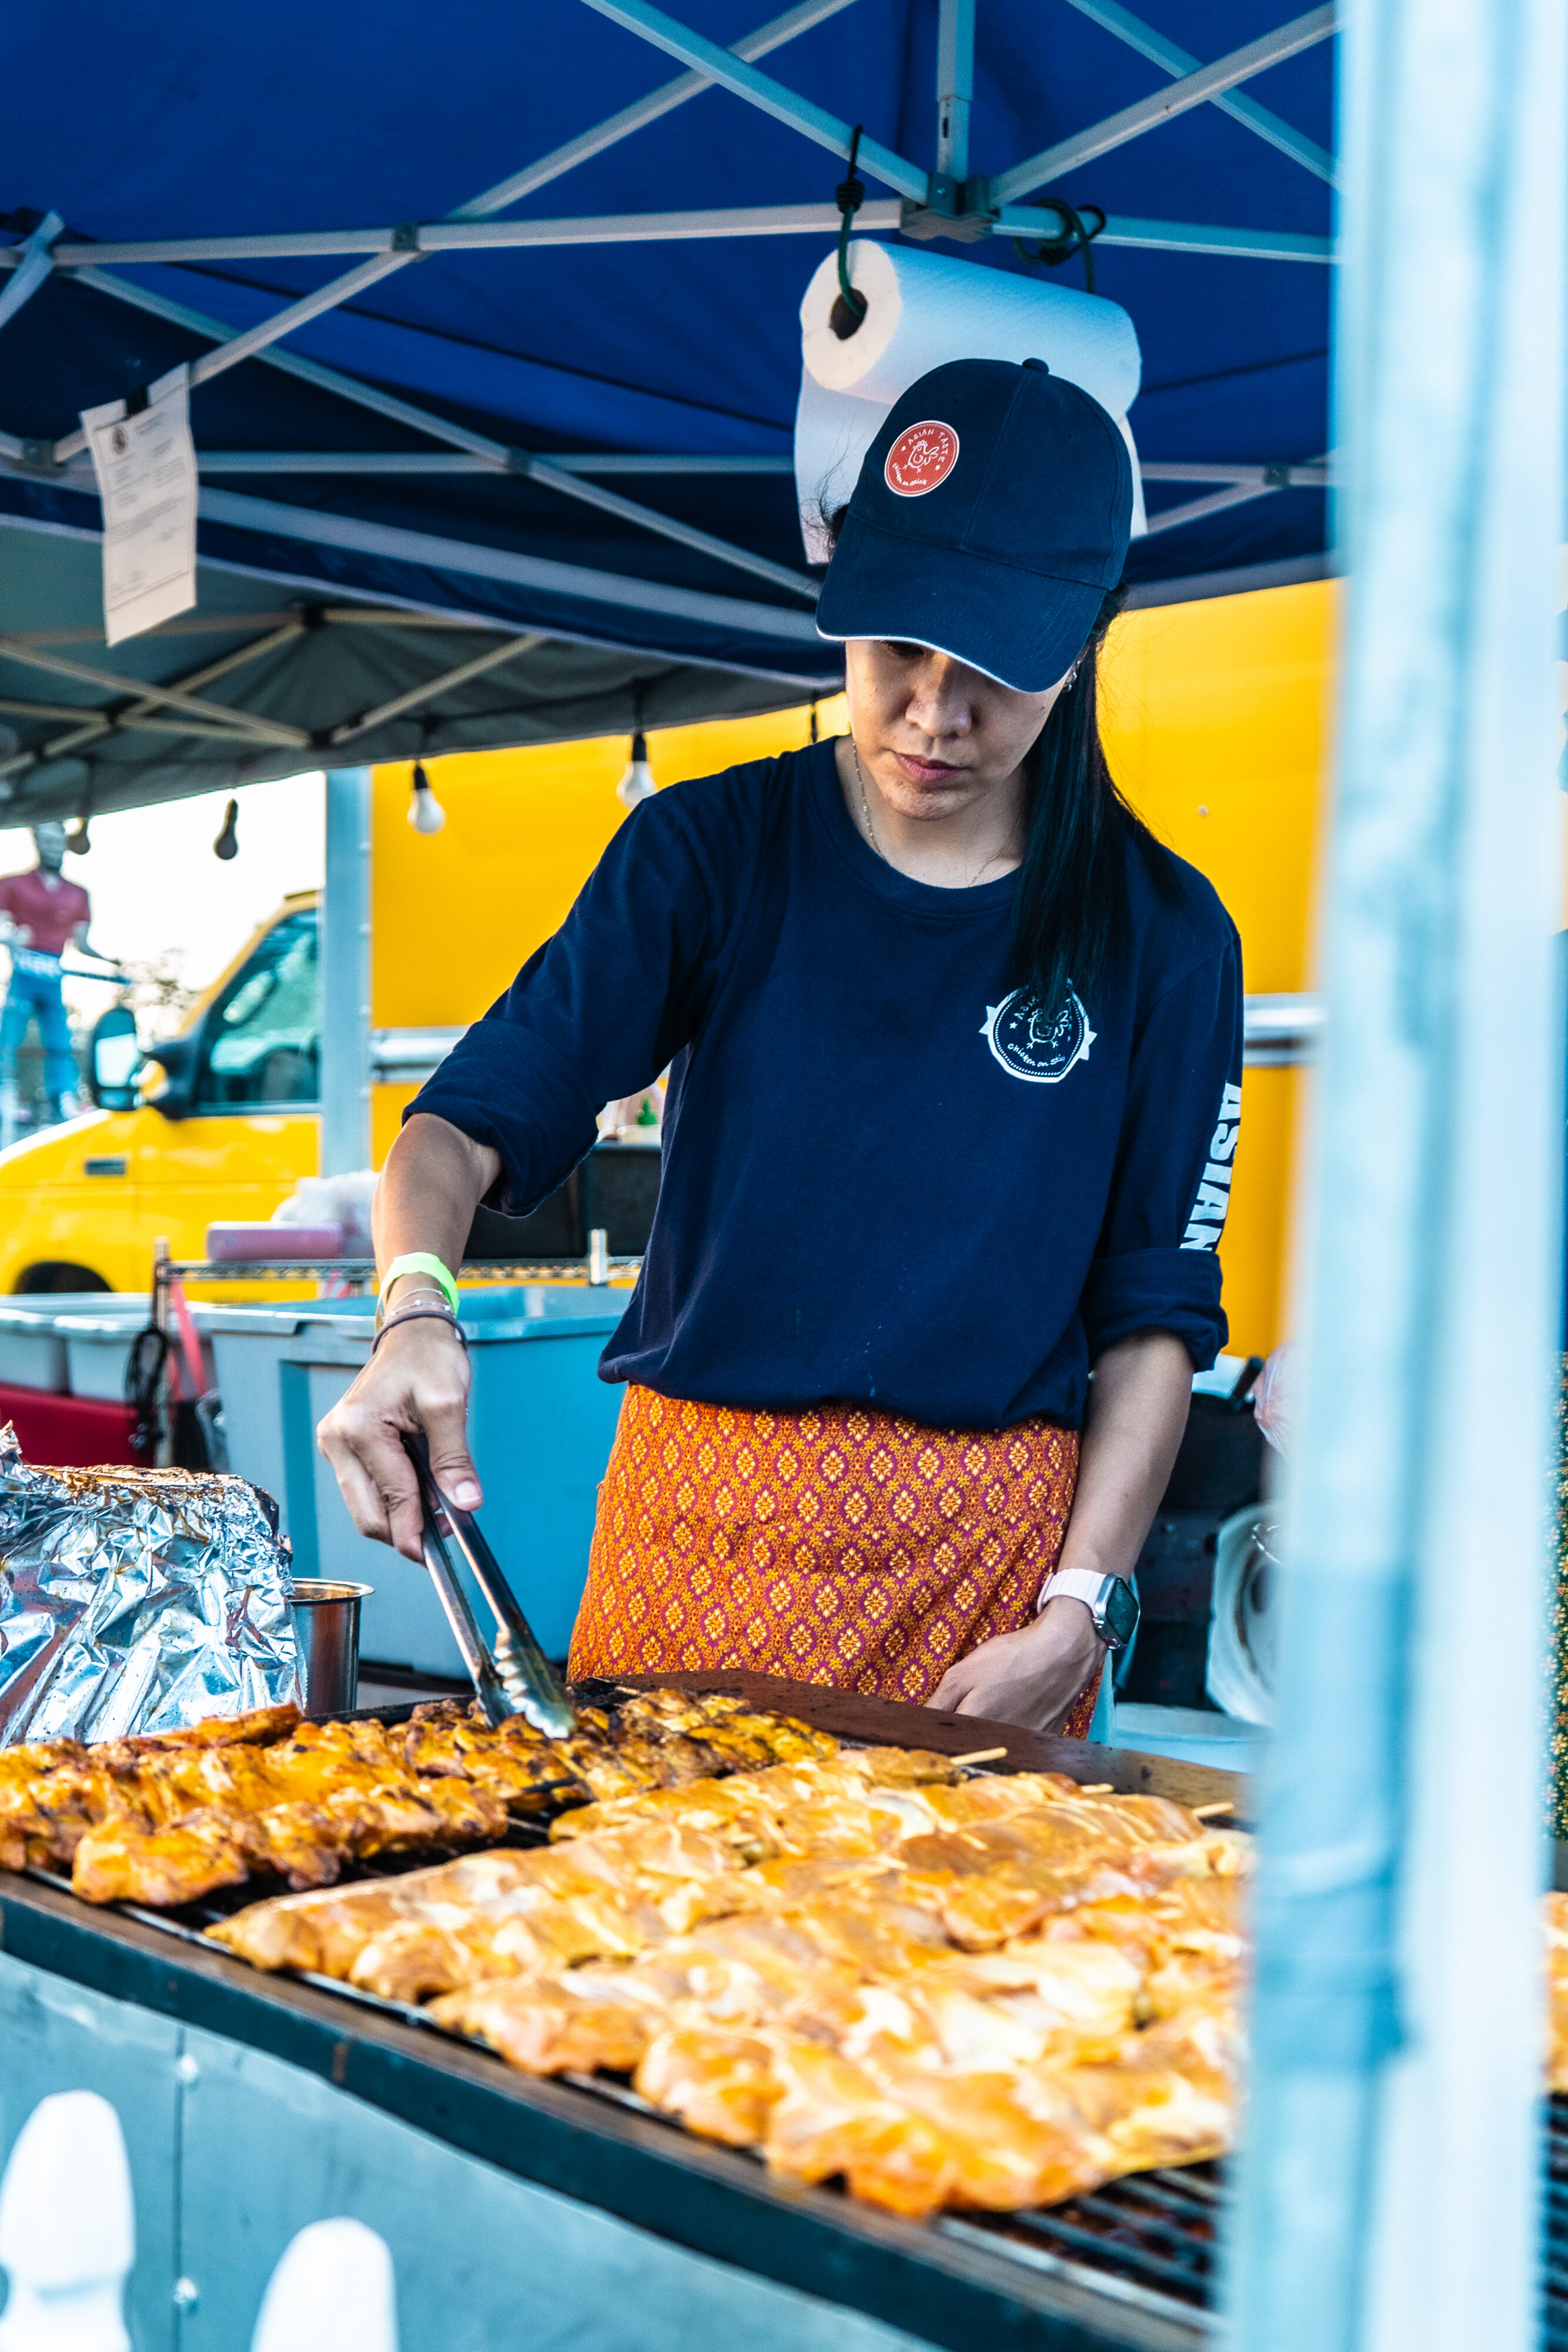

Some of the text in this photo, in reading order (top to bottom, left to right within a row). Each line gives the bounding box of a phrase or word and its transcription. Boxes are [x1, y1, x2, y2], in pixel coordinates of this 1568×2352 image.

[908, 428, 949, 463] ASIAN TASTE
[1179, 1082, 1242, 1252] ASIAN
